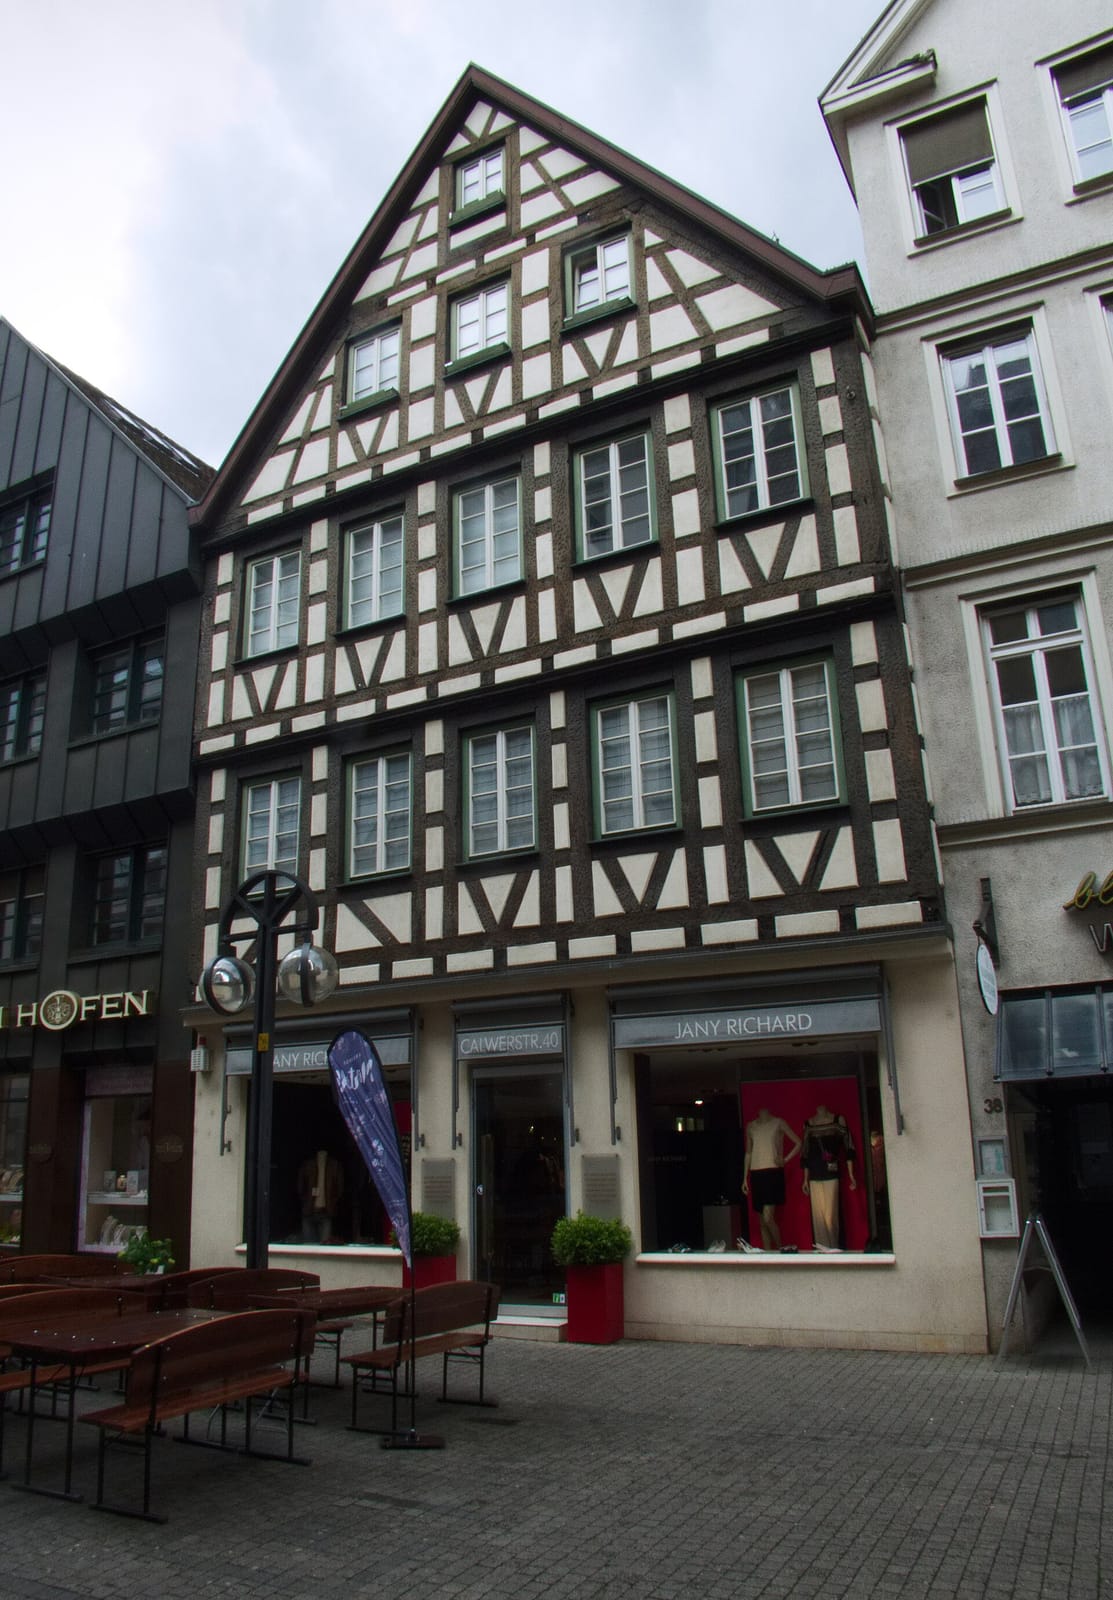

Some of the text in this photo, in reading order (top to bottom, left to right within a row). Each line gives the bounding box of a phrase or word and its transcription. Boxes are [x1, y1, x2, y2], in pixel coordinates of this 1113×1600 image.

[674, 1013, 812, 1039] JANY RICHARD
[273, 1051, 300, 1068] ANY
[983, 1098, 1003, 1113] 38
